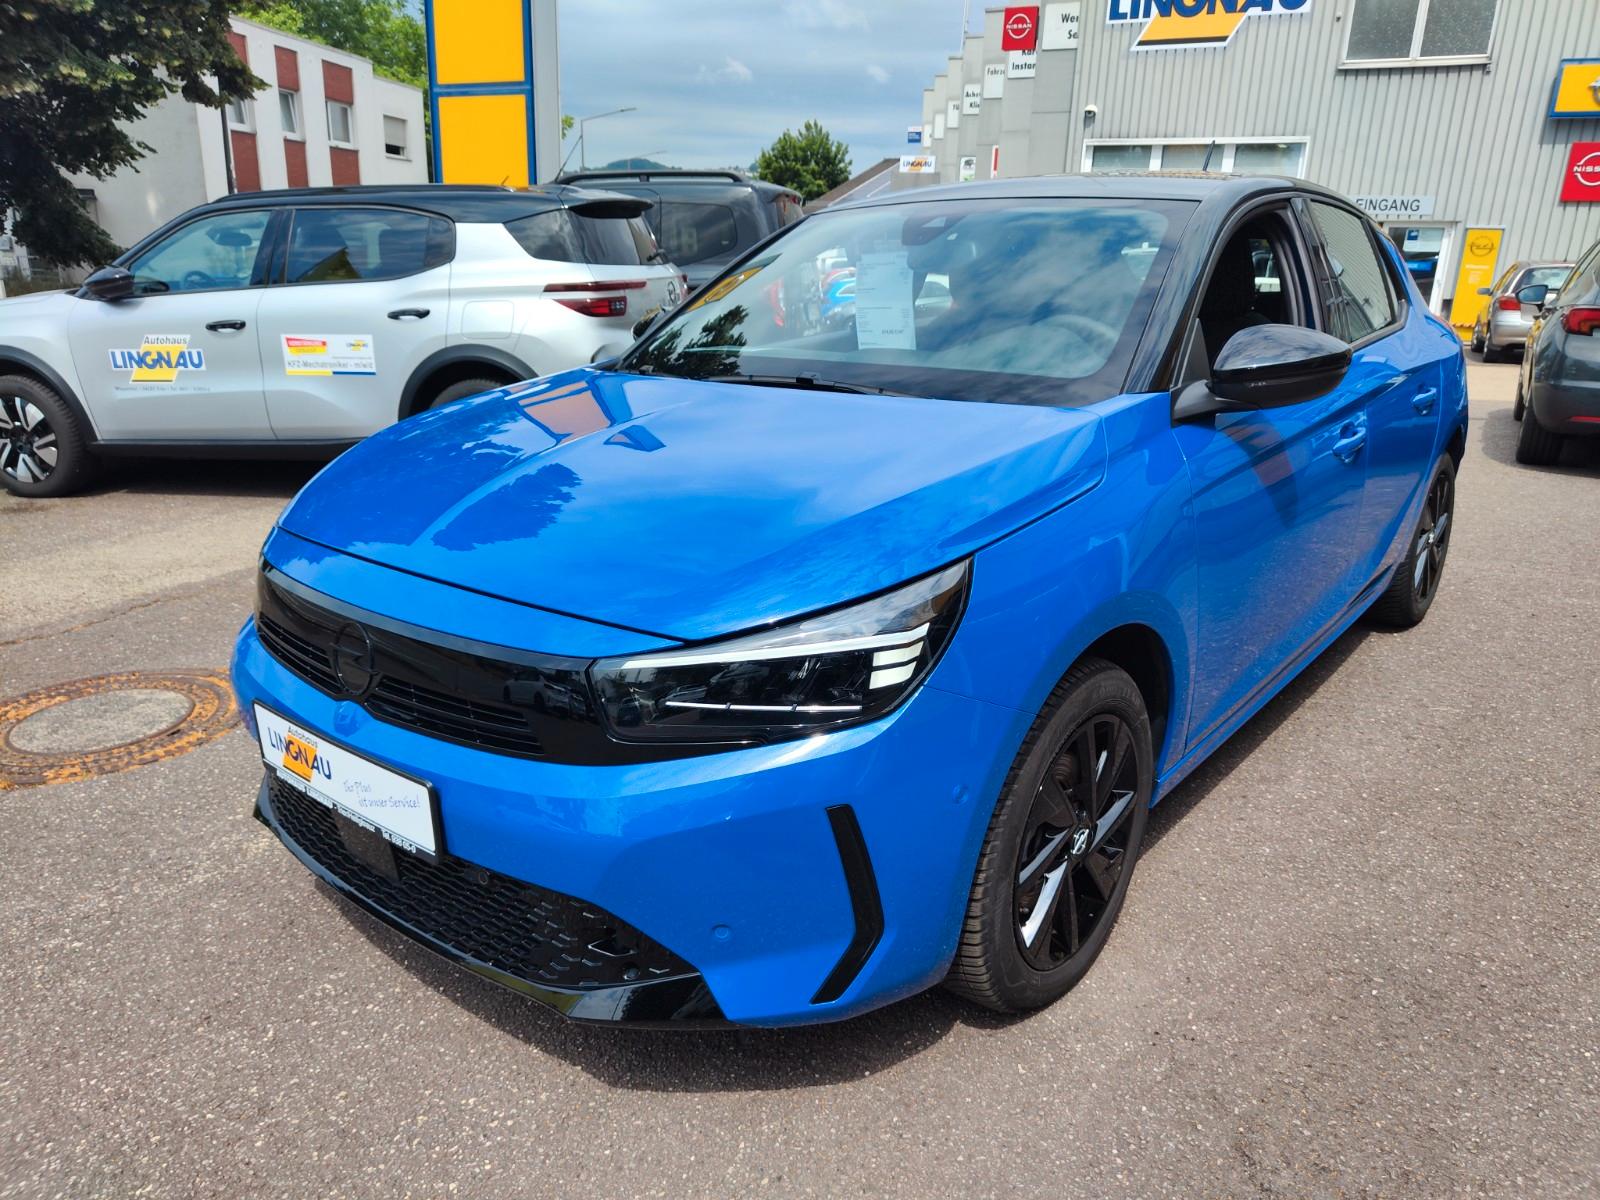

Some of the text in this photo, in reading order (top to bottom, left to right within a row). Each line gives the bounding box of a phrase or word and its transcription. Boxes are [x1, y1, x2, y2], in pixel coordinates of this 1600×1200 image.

[1109, 0, 1307, 21] LING
[143, 335, 188, 345] Autohaus
[110, 350, 203, 370] LINGNAU
[267, 726, 332, 780] LINGNAU
